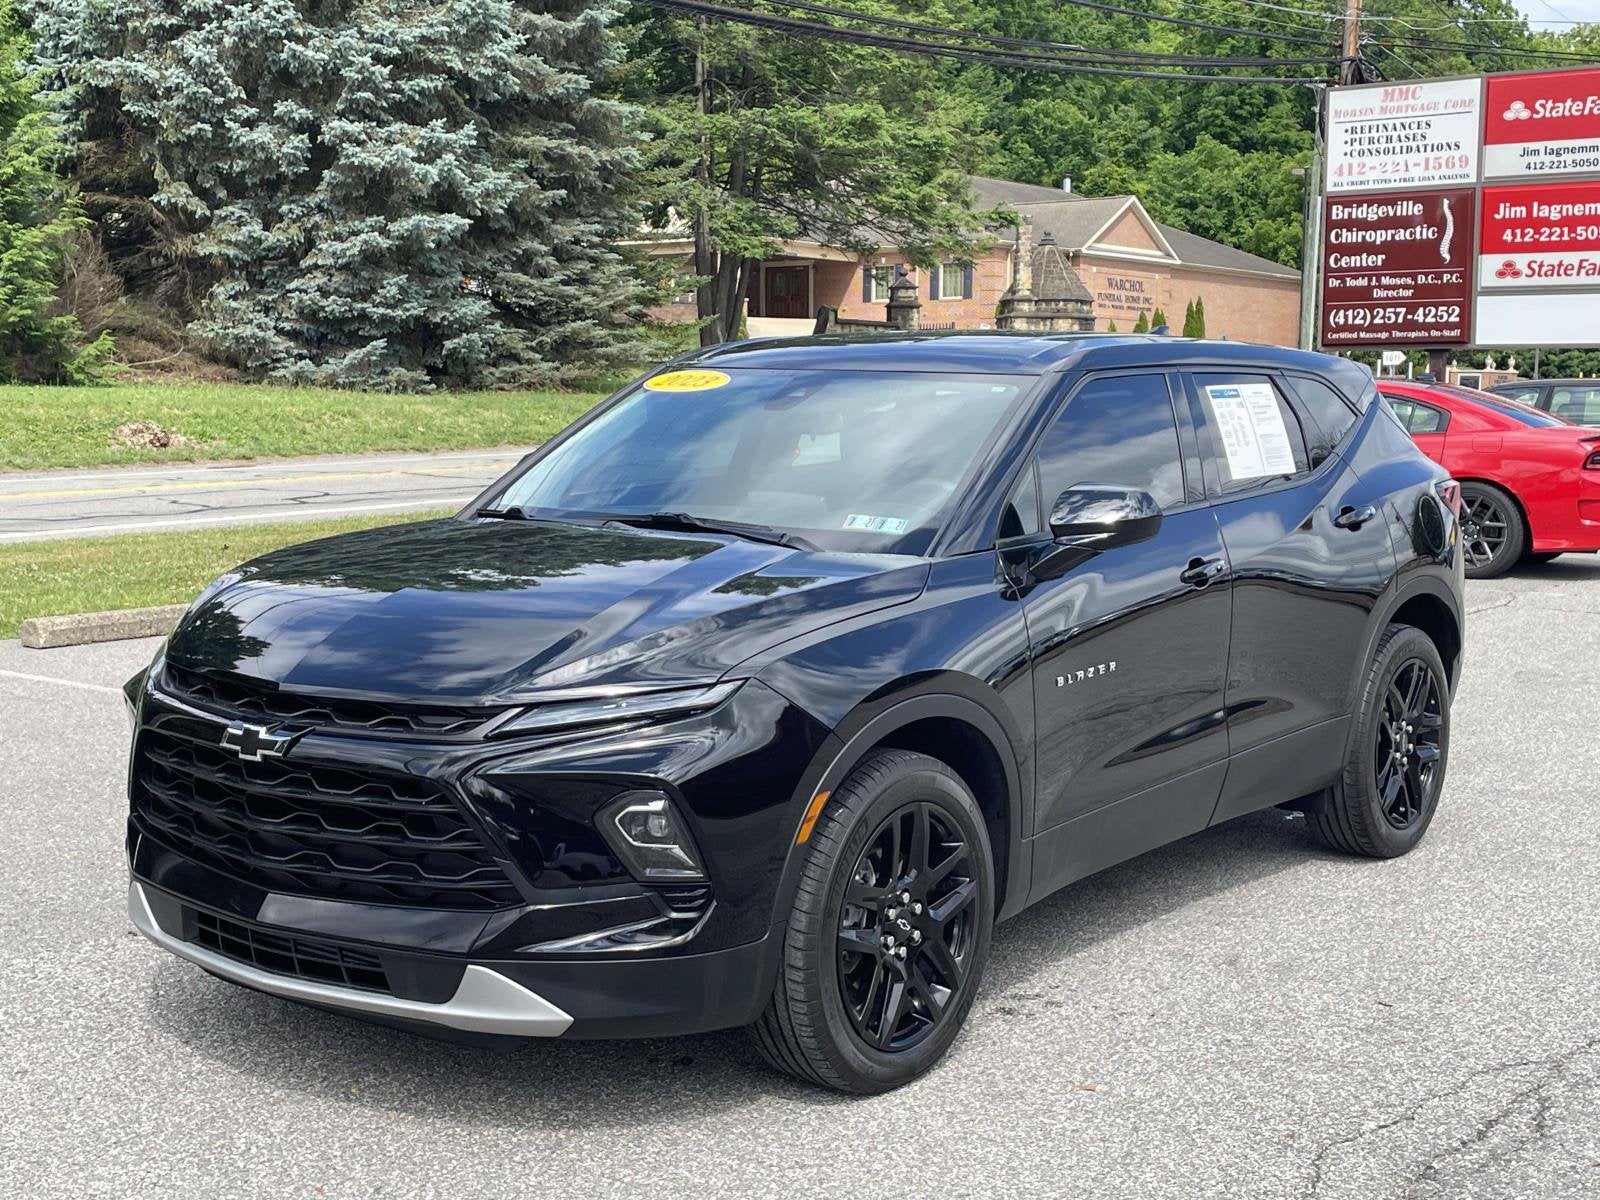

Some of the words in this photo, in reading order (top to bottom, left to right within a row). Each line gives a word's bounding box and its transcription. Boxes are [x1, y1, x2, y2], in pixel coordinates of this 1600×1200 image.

[1381, 86, 1423, 103] MMC
[1379, 101, 1440, 115] MORTGAGE
[1350, 120, 1432, 135] REFINANCES
[1350, 132, 1427, 147] PURCHASES
[1349, 141, 1461, 158] CONSOLIDATIONS
[1520, 147, 1540, 157] Jim
[1334, 154, 1469, 177] 412-221-1569
[1525, 158, 1599, 171] 412-221-5050
[1346, 179, 1370, 187] CREDIT
[1371, 178, 1392, 186] TYPES
[1399, 176, 1416, 184] FREE
[1418, 174, 1436, 182] LOAN
[1437, 172, 1470, 180] ANALYSIS
[1331, 200, 1424, 221] Bridgeville
[1494, 202, 1527, 219] Jim
[1330, 224, 1438, 245] Chiropractic
[1502, 226, 1600, 242] 412-221-50
[1329, 252, 1386, 268] Center
[1107, 278, 1145, 292] WARCHOL
[1328, 278, 1344, 288] Dr.
[1345, 276, 1368, 287] Todd
[1370, 276, 1378, 286] J.
[1381, 275, 1415, 286] Moses,
[1443, 273, 1463, 284] P.C.
[1097, 293, 1122, 303] FUNERAL
[1373, 287, 1414, 298] Director
[1329, 308, 1371, 328] (412)
[1373, 305, 1460, 325] 257-4252
[1327, 331, 1358, 340] Certified
[1359, 331, 1389, 340] Massage
[1391, 330, 1429, 339] Therapists
[1430, 329, 1462, 337] On-Staff
[1056, 661, 1117, 687] BLAZER
